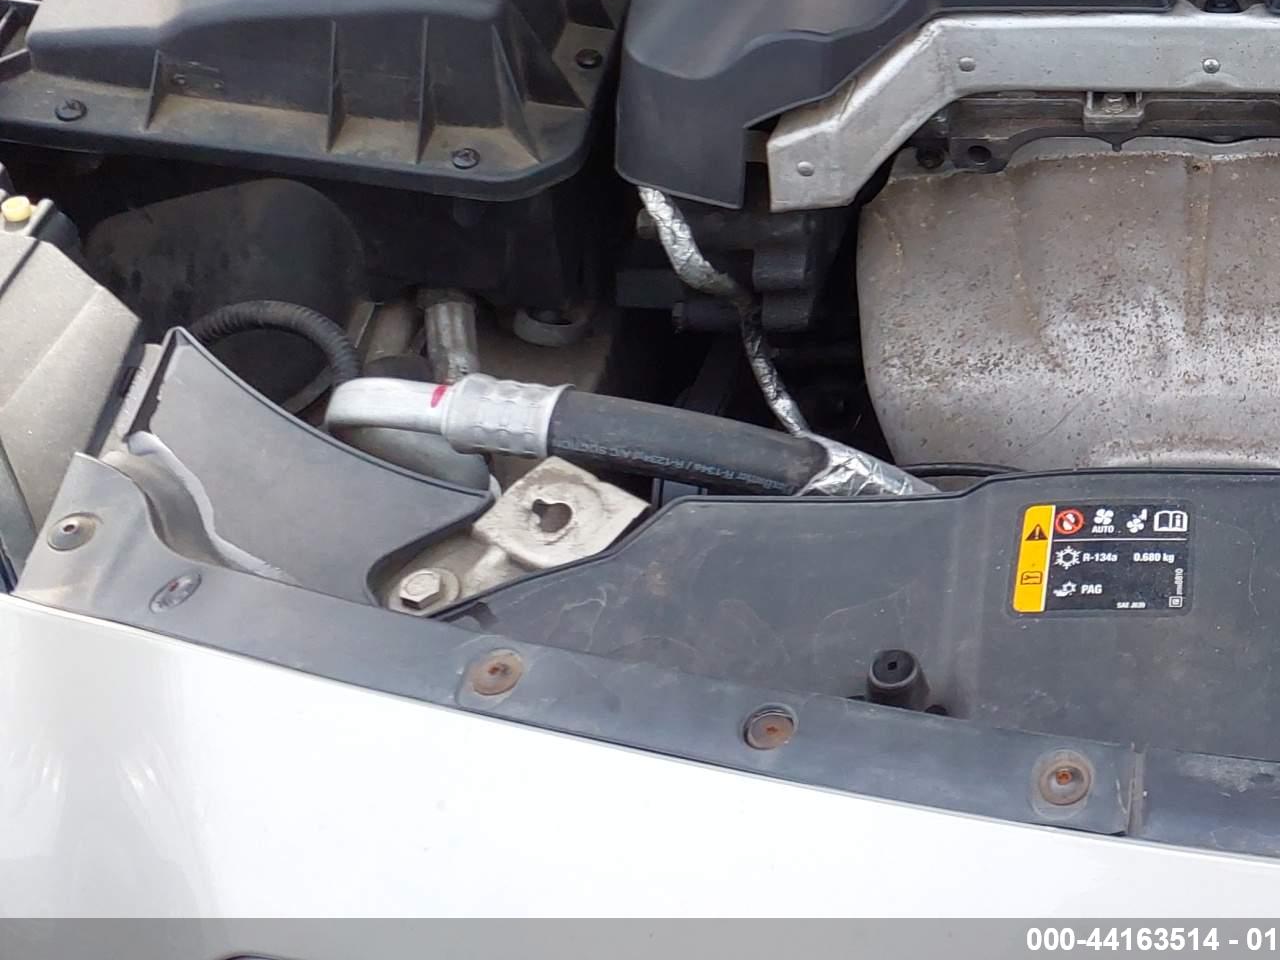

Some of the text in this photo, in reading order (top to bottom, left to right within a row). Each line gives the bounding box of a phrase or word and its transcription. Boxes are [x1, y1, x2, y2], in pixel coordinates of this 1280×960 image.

[1092, 525, 1114, 534] AUTO
[1082, 552, 1175, 564] R-134a 0.680 kg
[1081, 584, 1103, 594] PAG
